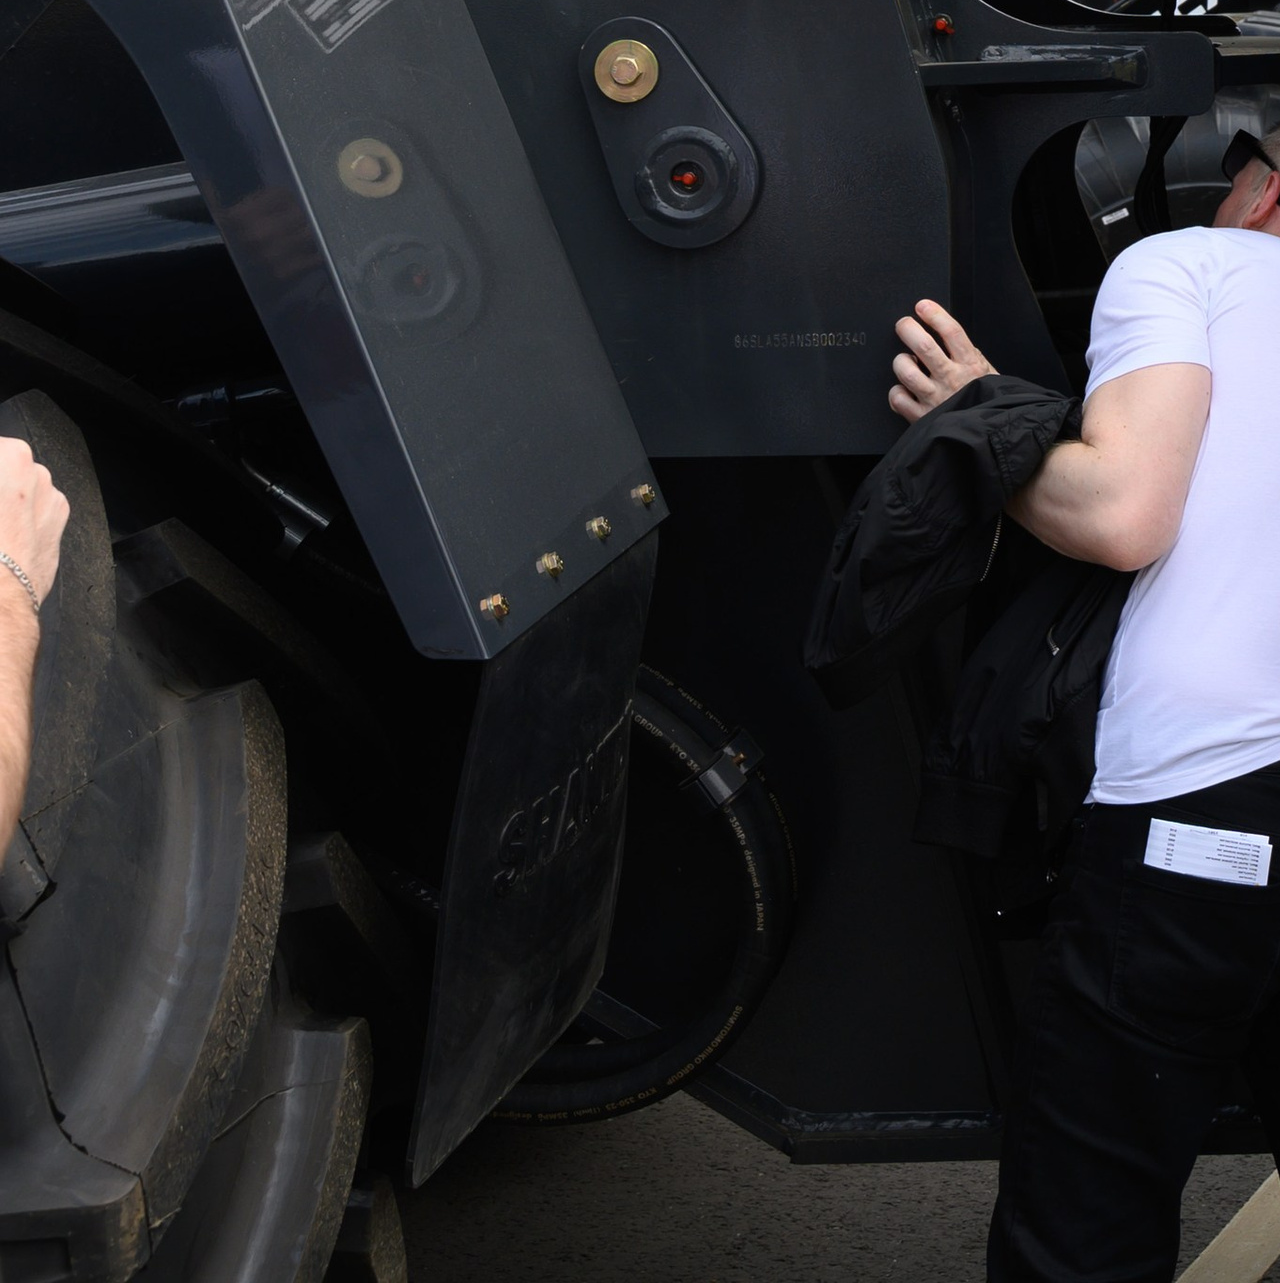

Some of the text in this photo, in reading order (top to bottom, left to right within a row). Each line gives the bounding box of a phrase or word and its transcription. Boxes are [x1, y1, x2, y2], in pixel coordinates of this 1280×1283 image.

[633, 714, 664, 739] GROUP
[669, 742, 688, 760] KYO
[728, 816, 766, 932] 35MPa designed in JAPAN
[710, 1004, 744, 1049] SUMITOMO
[693, 1044, 713, 1065] RIKO
[666, 1063, 696, 1086] GROUP
[637, 1086, 659, 1099] KYO
